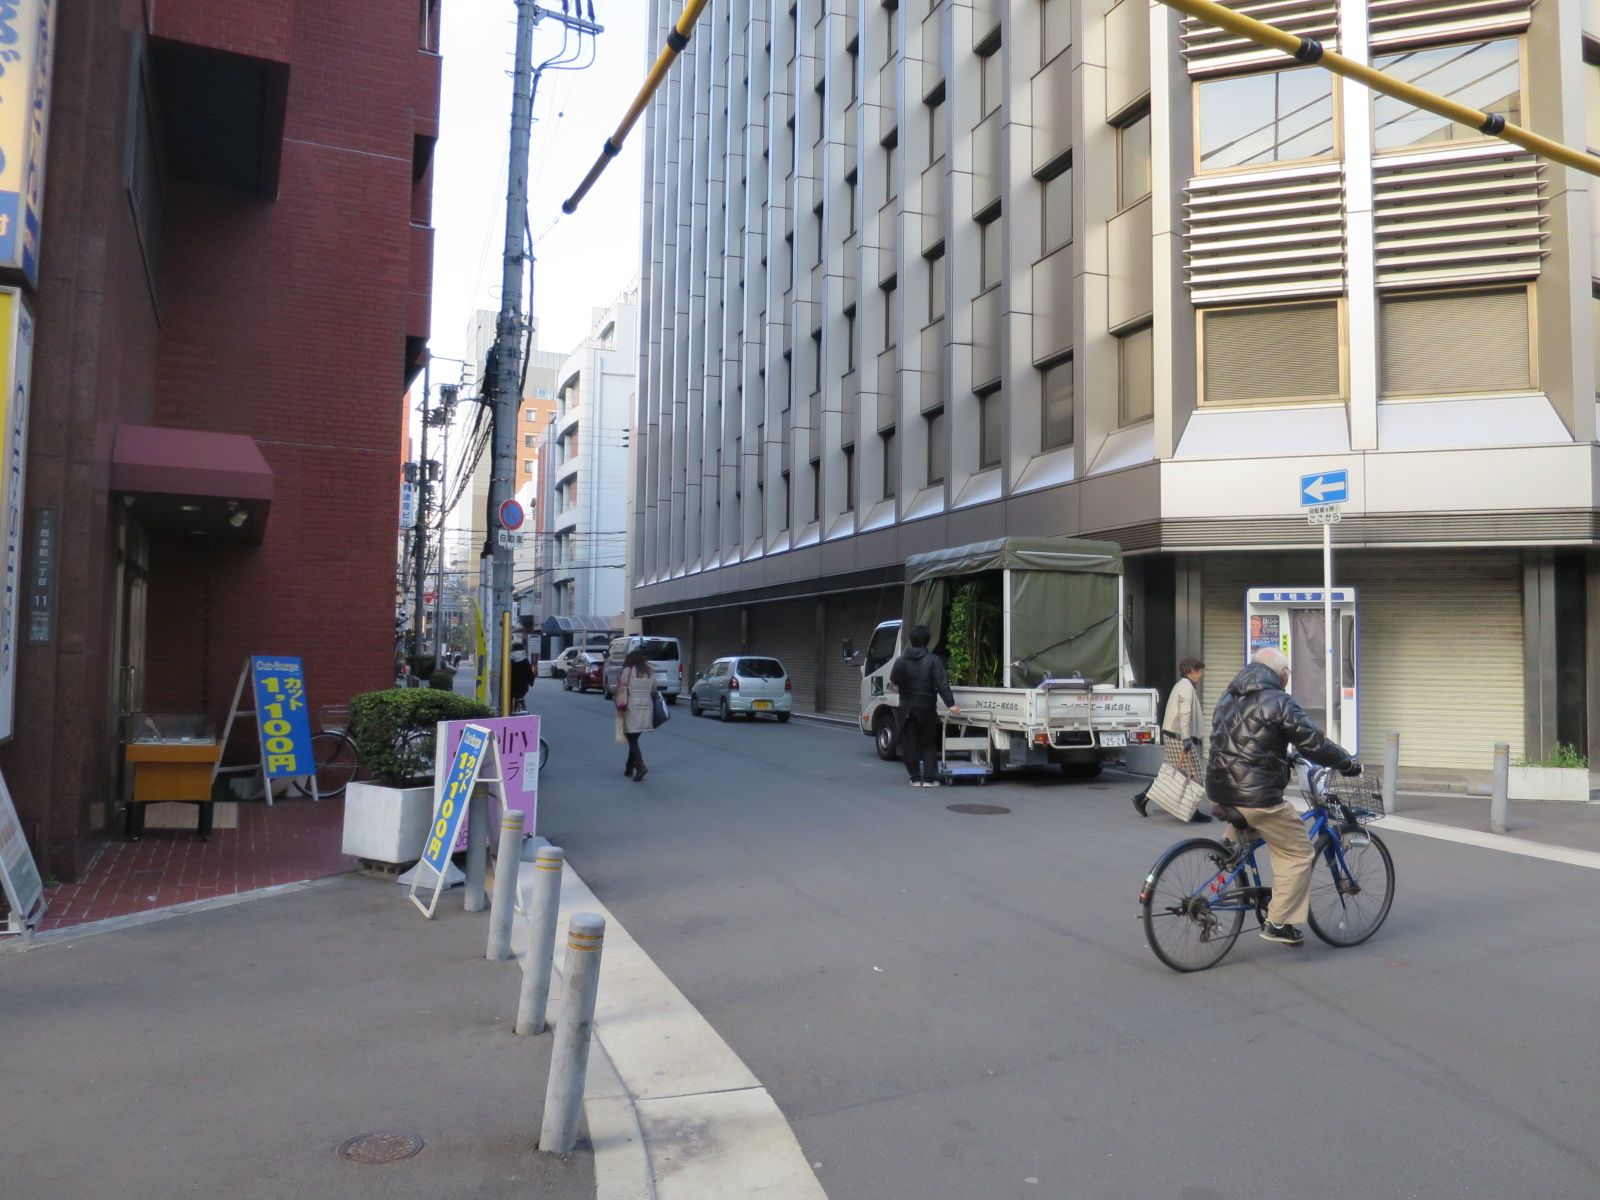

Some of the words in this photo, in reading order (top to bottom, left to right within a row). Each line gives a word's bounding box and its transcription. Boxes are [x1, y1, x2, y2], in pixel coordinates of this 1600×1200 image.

[35, 596, 47, 606] 11
[284, 677, 304, 711] カット
[261, 677, 297, 773] 1,100円
[459, 753, 476, 793] カット
[427, 752, 469, 861] 1,100円
